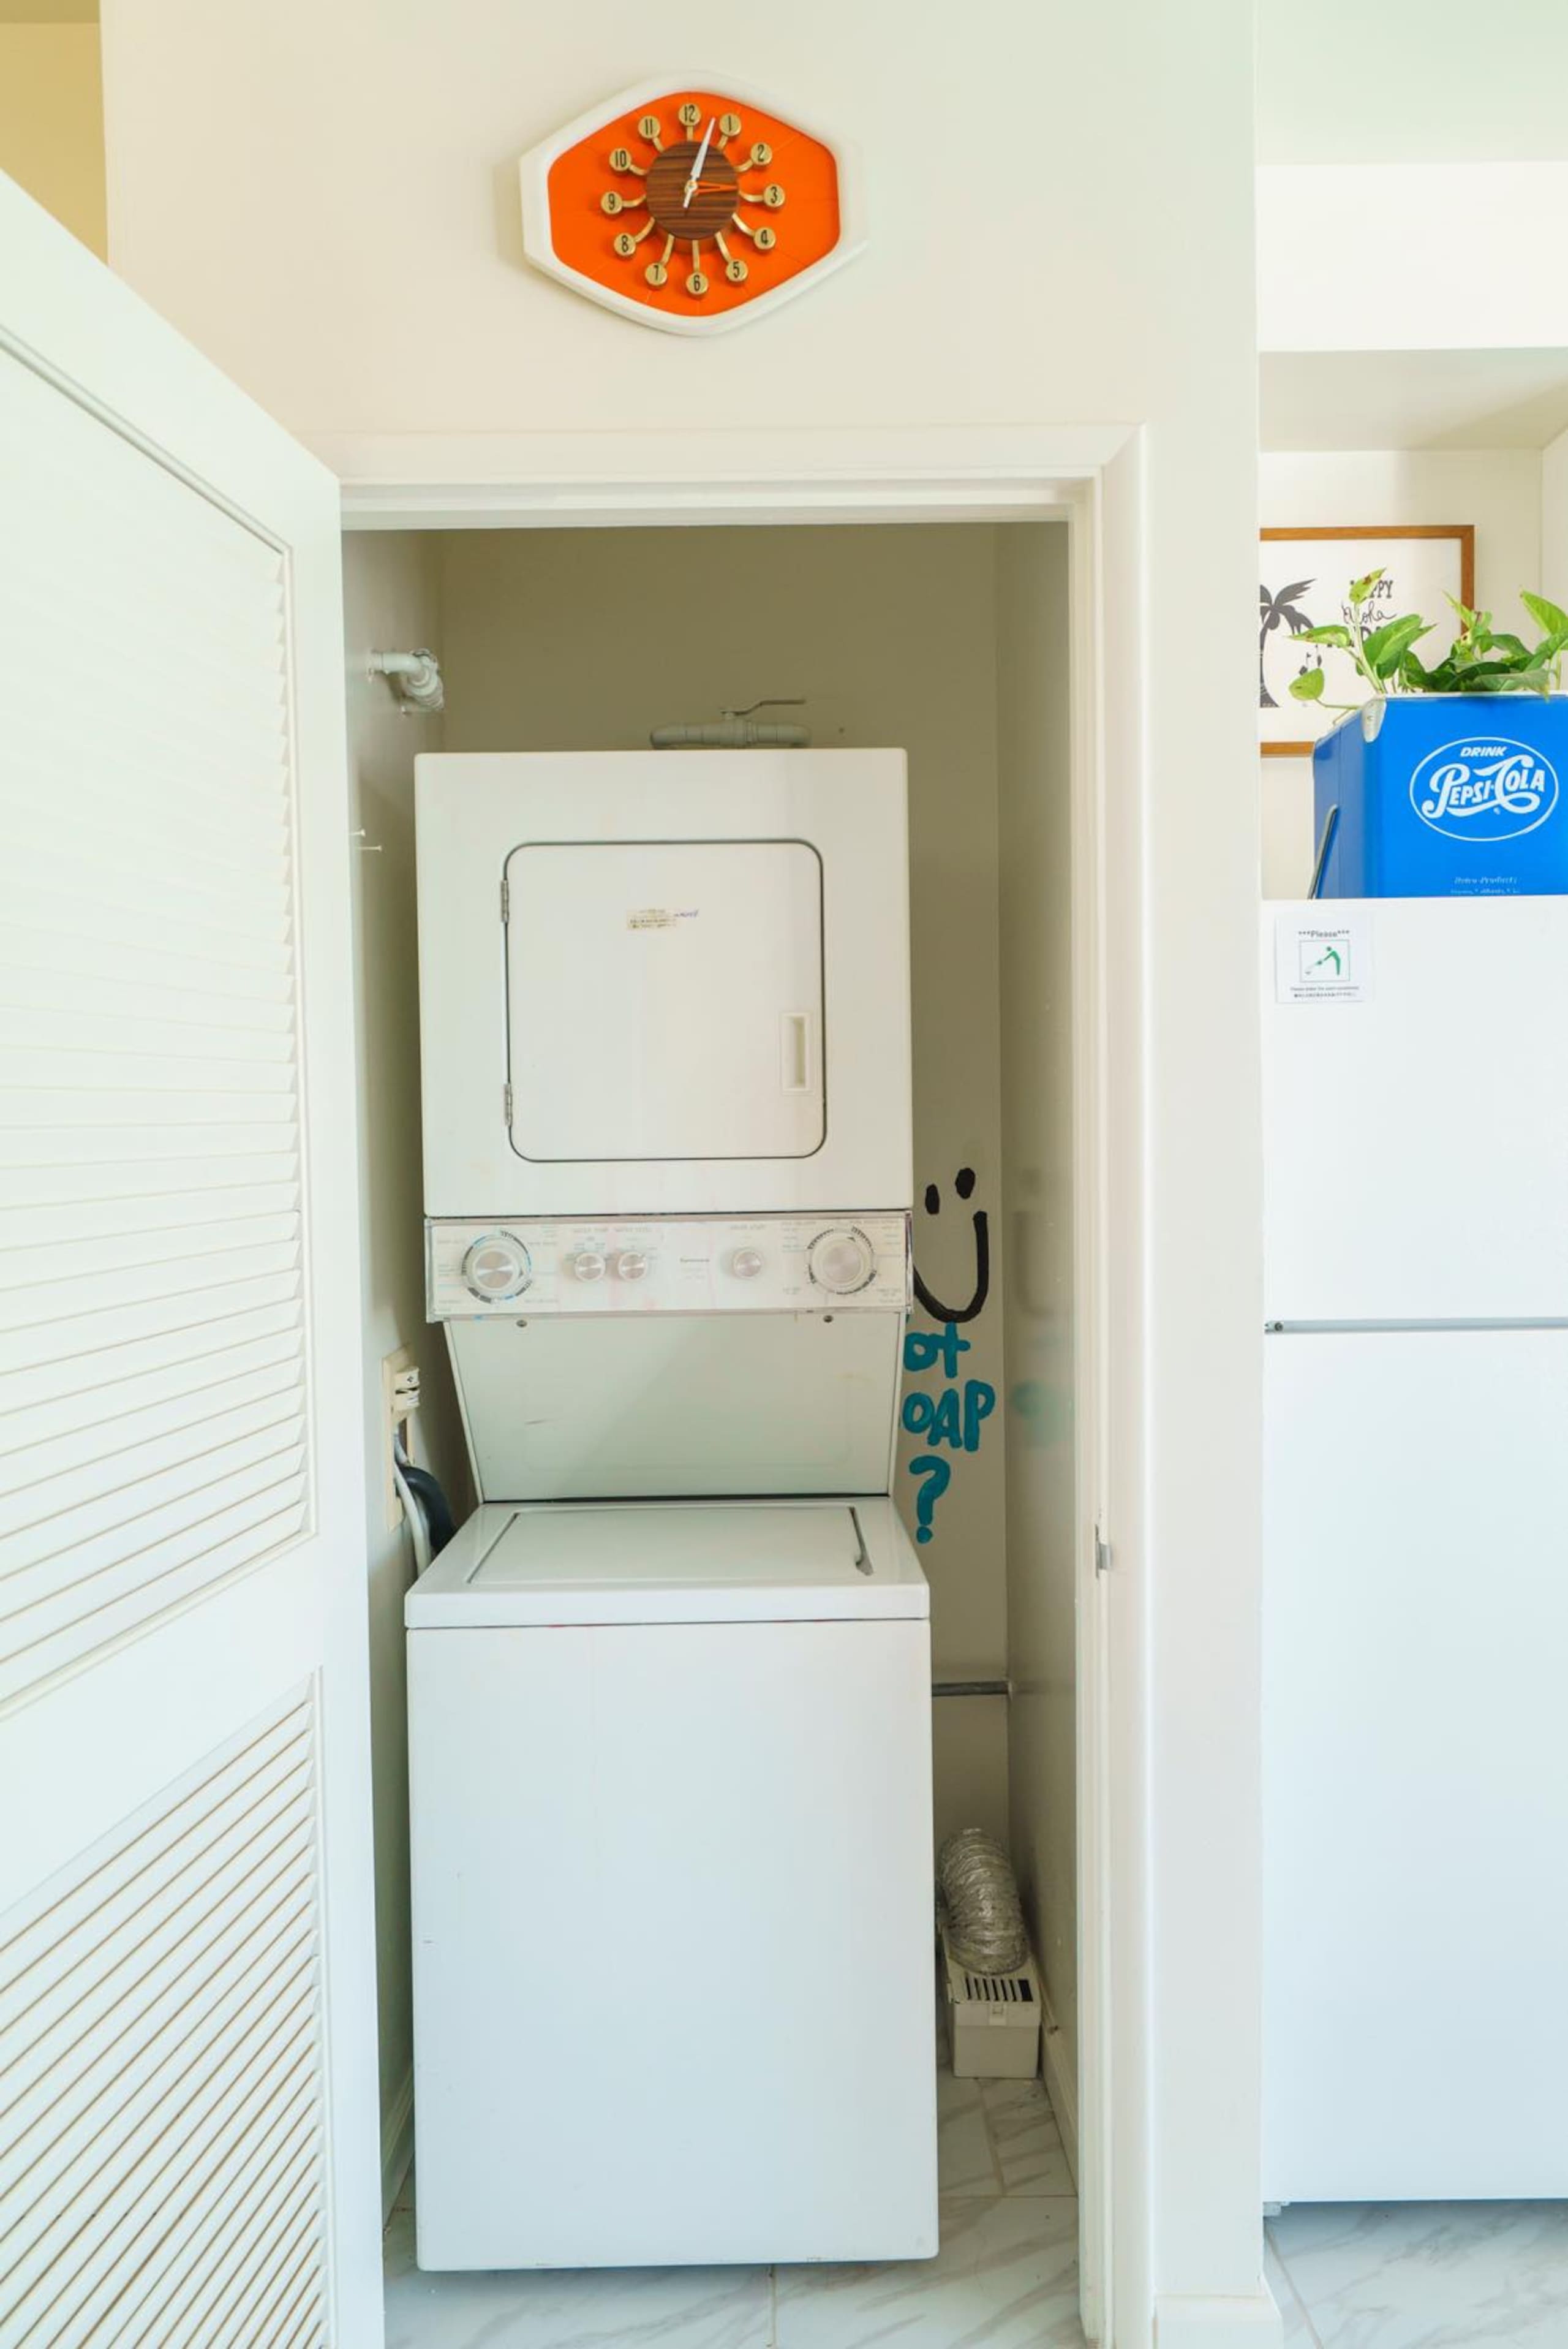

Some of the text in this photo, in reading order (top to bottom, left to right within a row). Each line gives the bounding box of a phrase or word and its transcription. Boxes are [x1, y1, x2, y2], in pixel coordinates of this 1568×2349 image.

[684, 105, 695, 123] 12
[644, 119, 653, 134] 11
[615, 151, 627, 166] 10
[758, 144, 765, 162] 2
[608, 195, 615, 210] 9
[771, 186, 778, 203] 3
[621, 235, 629, 252] 8
[760, 230, 768, 244] 4
[653, 265, 660, 280] 7
[733, 261, 740, 278] 5
[693, 274, 700, 292] 6
[1460, 746, 1507, 757] DRINK
[903, 1315, 971, 1379] ot
[899, 1379, 996, 1453] OAP
[909, 1454, 951, 1543] ?
